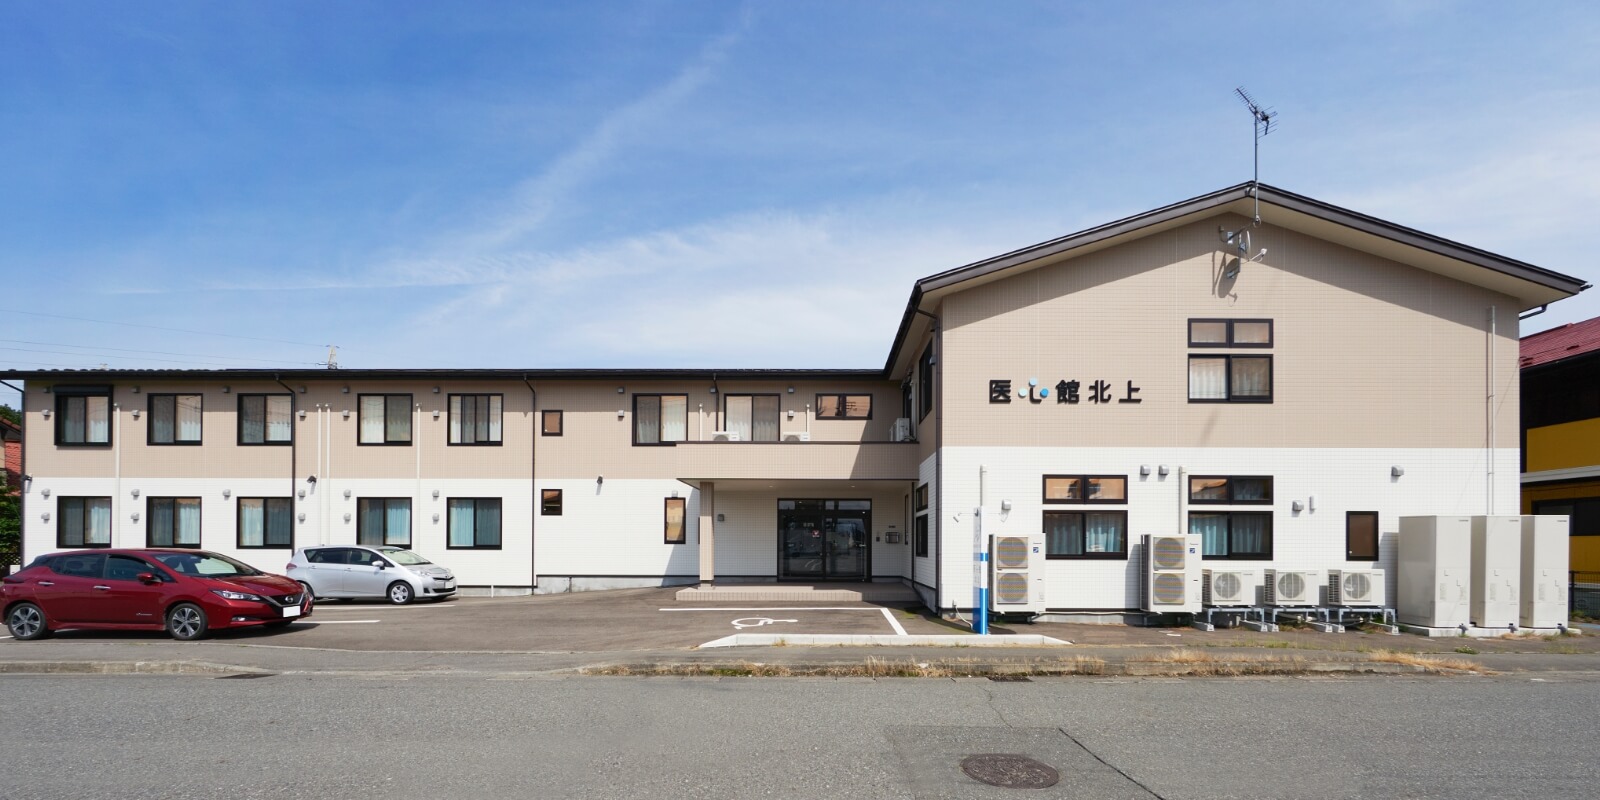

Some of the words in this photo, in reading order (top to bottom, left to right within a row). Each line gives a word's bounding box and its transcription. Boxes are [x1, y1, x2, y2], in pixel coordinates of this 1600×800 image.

[989, 377, 1142, 404] 医心館北上
